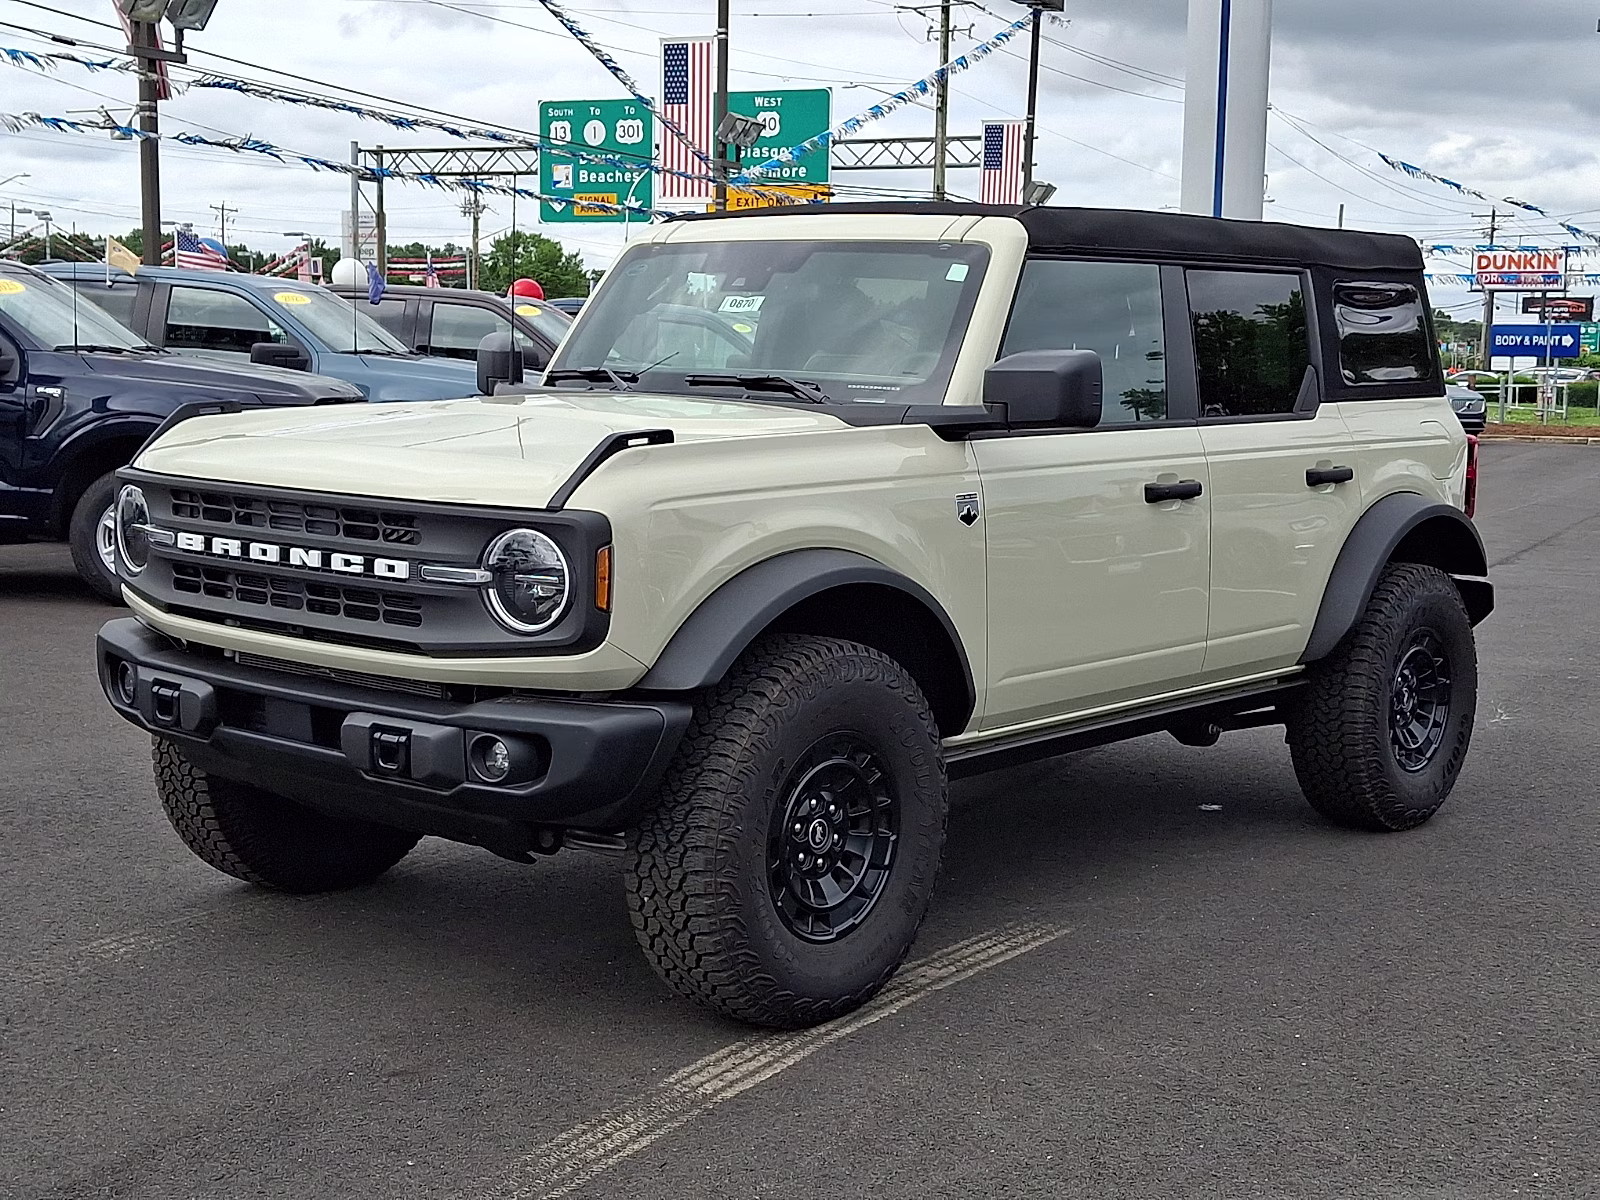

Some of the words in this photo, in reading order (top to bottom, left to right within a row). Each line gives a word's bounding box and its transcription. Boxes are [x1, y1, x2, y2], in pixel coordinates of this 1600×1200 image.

[754, 97, 782, 107] WEST
[548, 108, 574, 117] SOUTH
[555, 126, 567, 140] 13
[619, 125, 640, 138] 301
[579, 170, 640, 183] Beaches
[736, 197, 760, 208] EXIT
[1477, 254, 1563, 270] DUNKIN'
[729, 298, 755, 308] 0870
[1495, 335, 1522, 346] BODY
[1523, 335, 1530, 346] &
[177, 531, 410, 580] BRONCO
